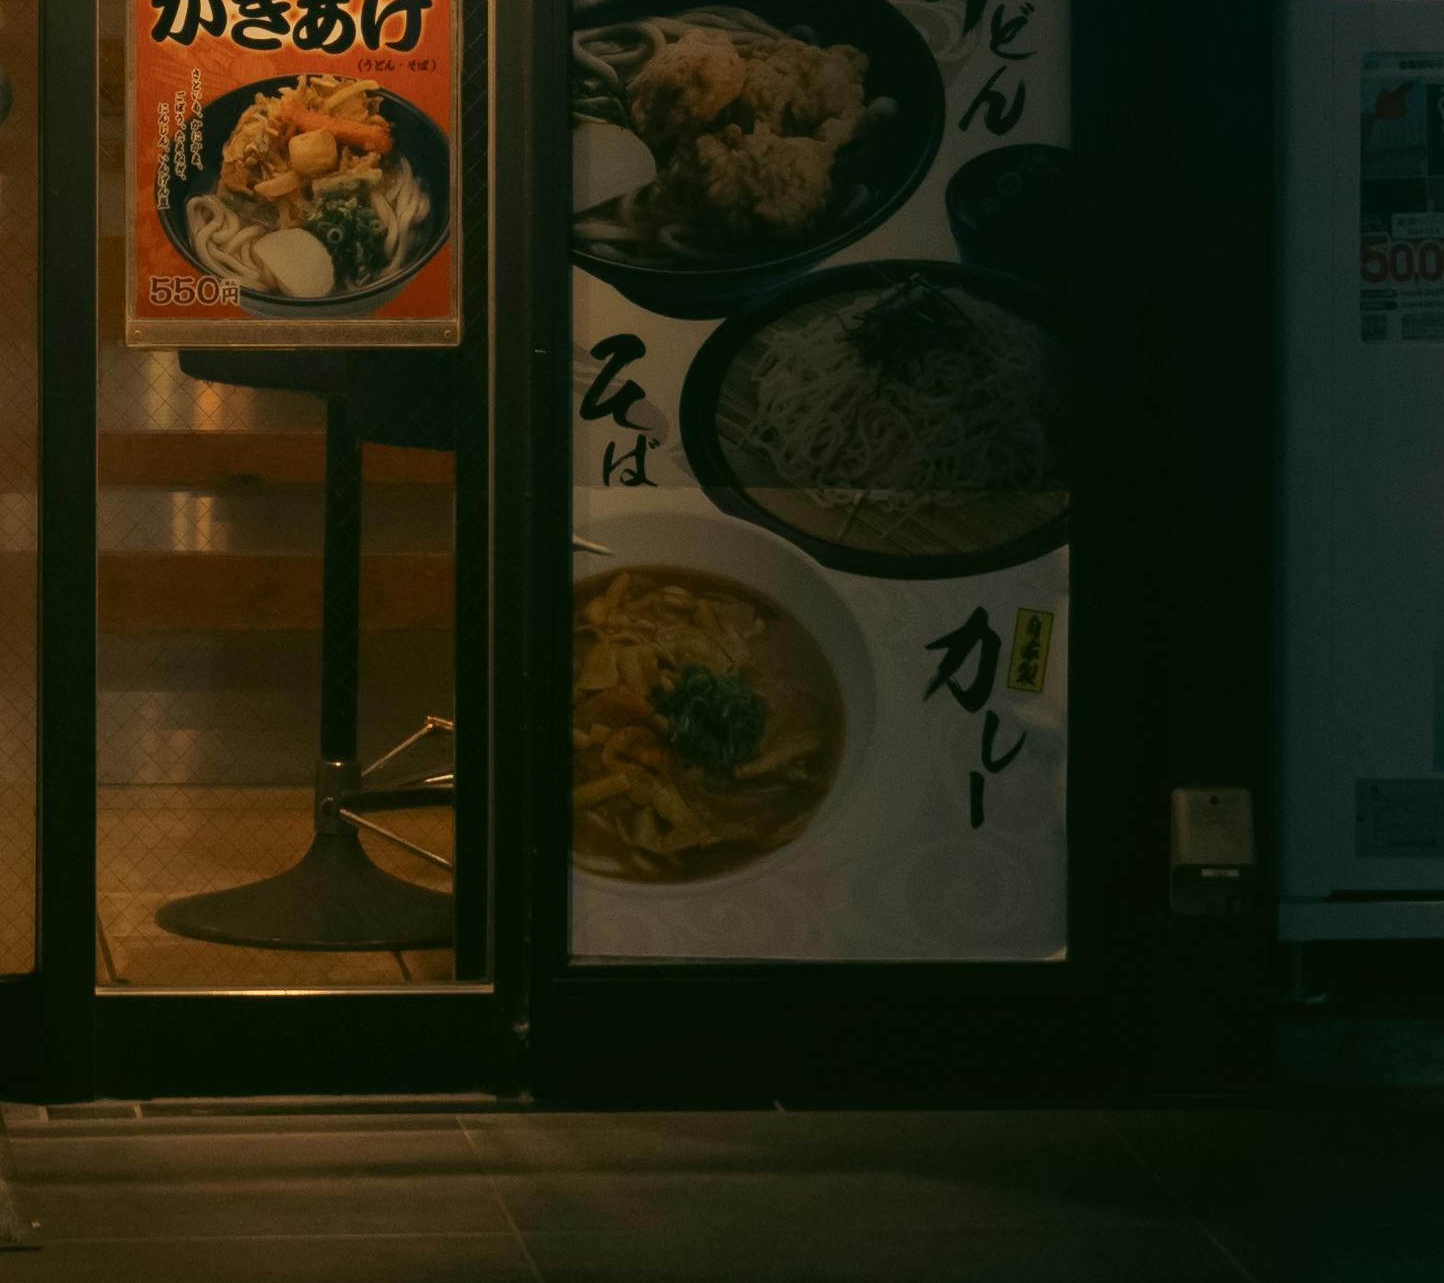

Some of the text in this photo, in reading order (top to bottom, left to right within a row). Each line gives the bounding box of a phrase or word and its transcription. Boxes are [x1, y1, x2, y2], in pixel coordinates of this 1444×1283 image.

[357, 58, 438, 74] (うどん・そば)
[148, 275, 242, 306] 550円
[578, 333, 660, 489] そば
[923, 606, 1031, 830] カレー
